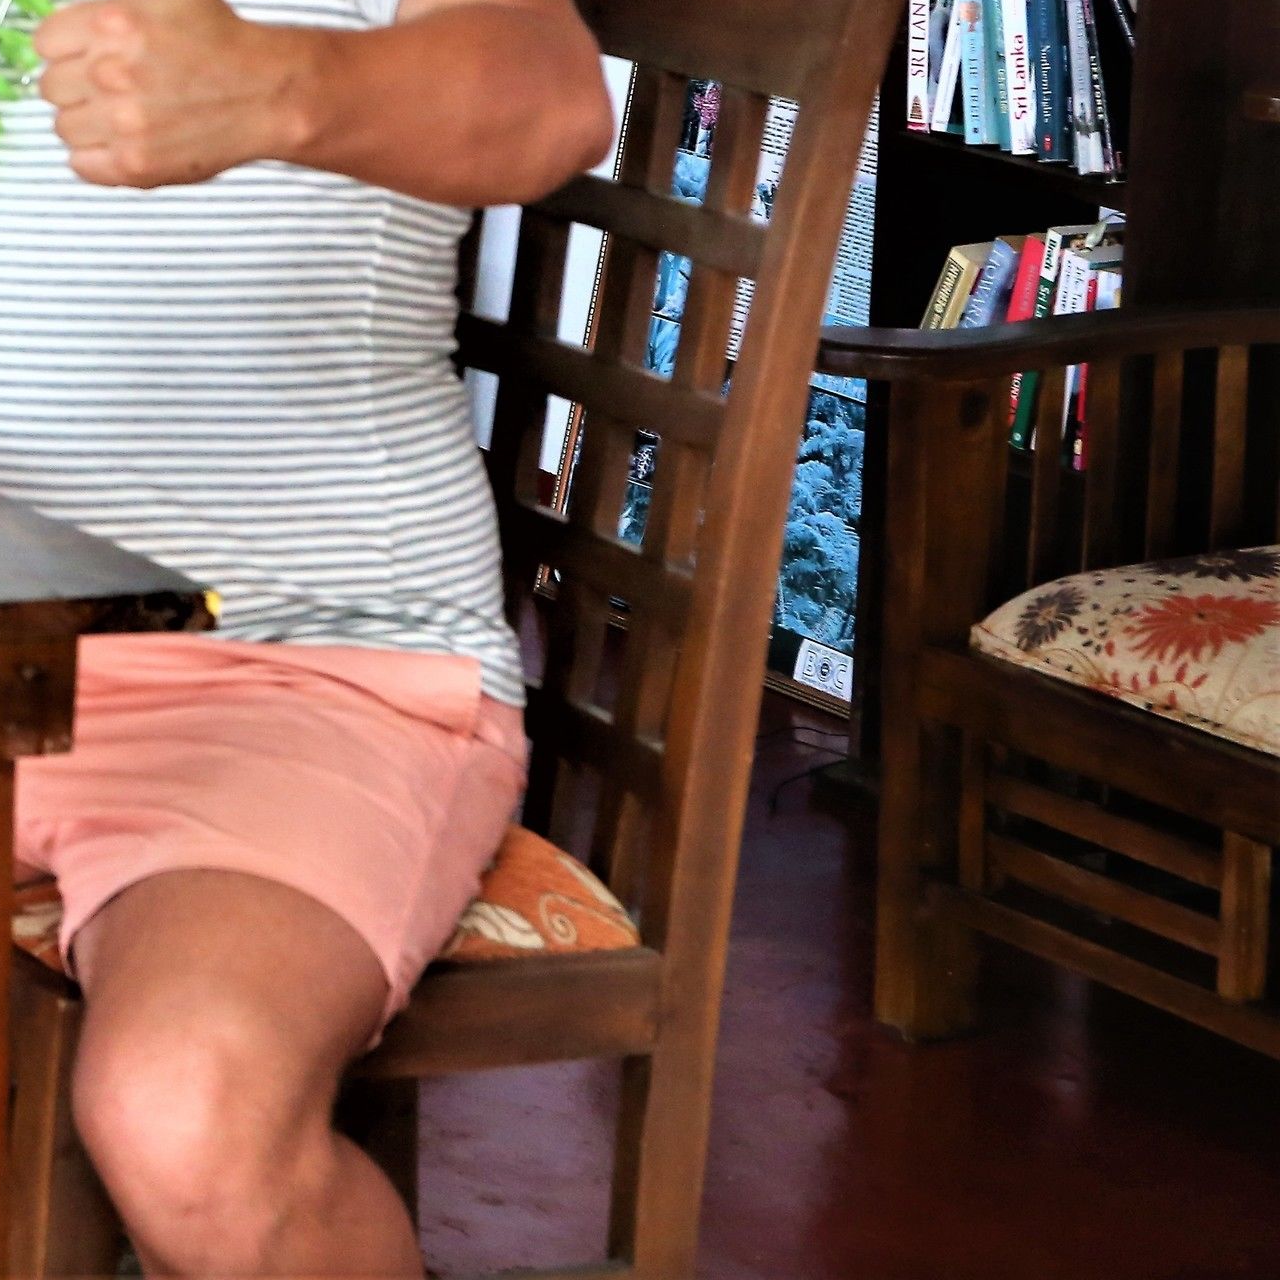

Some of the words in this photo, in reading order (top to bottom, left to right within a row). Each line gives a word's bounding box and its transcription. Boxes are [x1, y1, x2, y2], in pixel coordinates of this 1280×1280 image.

[910, 49, 926, 78] SRI
[1010, 33, 1028, 91] Lanka
[1012, 96, 1029, 120] Sri
[1093, 83, 1104, 120] FORCE
